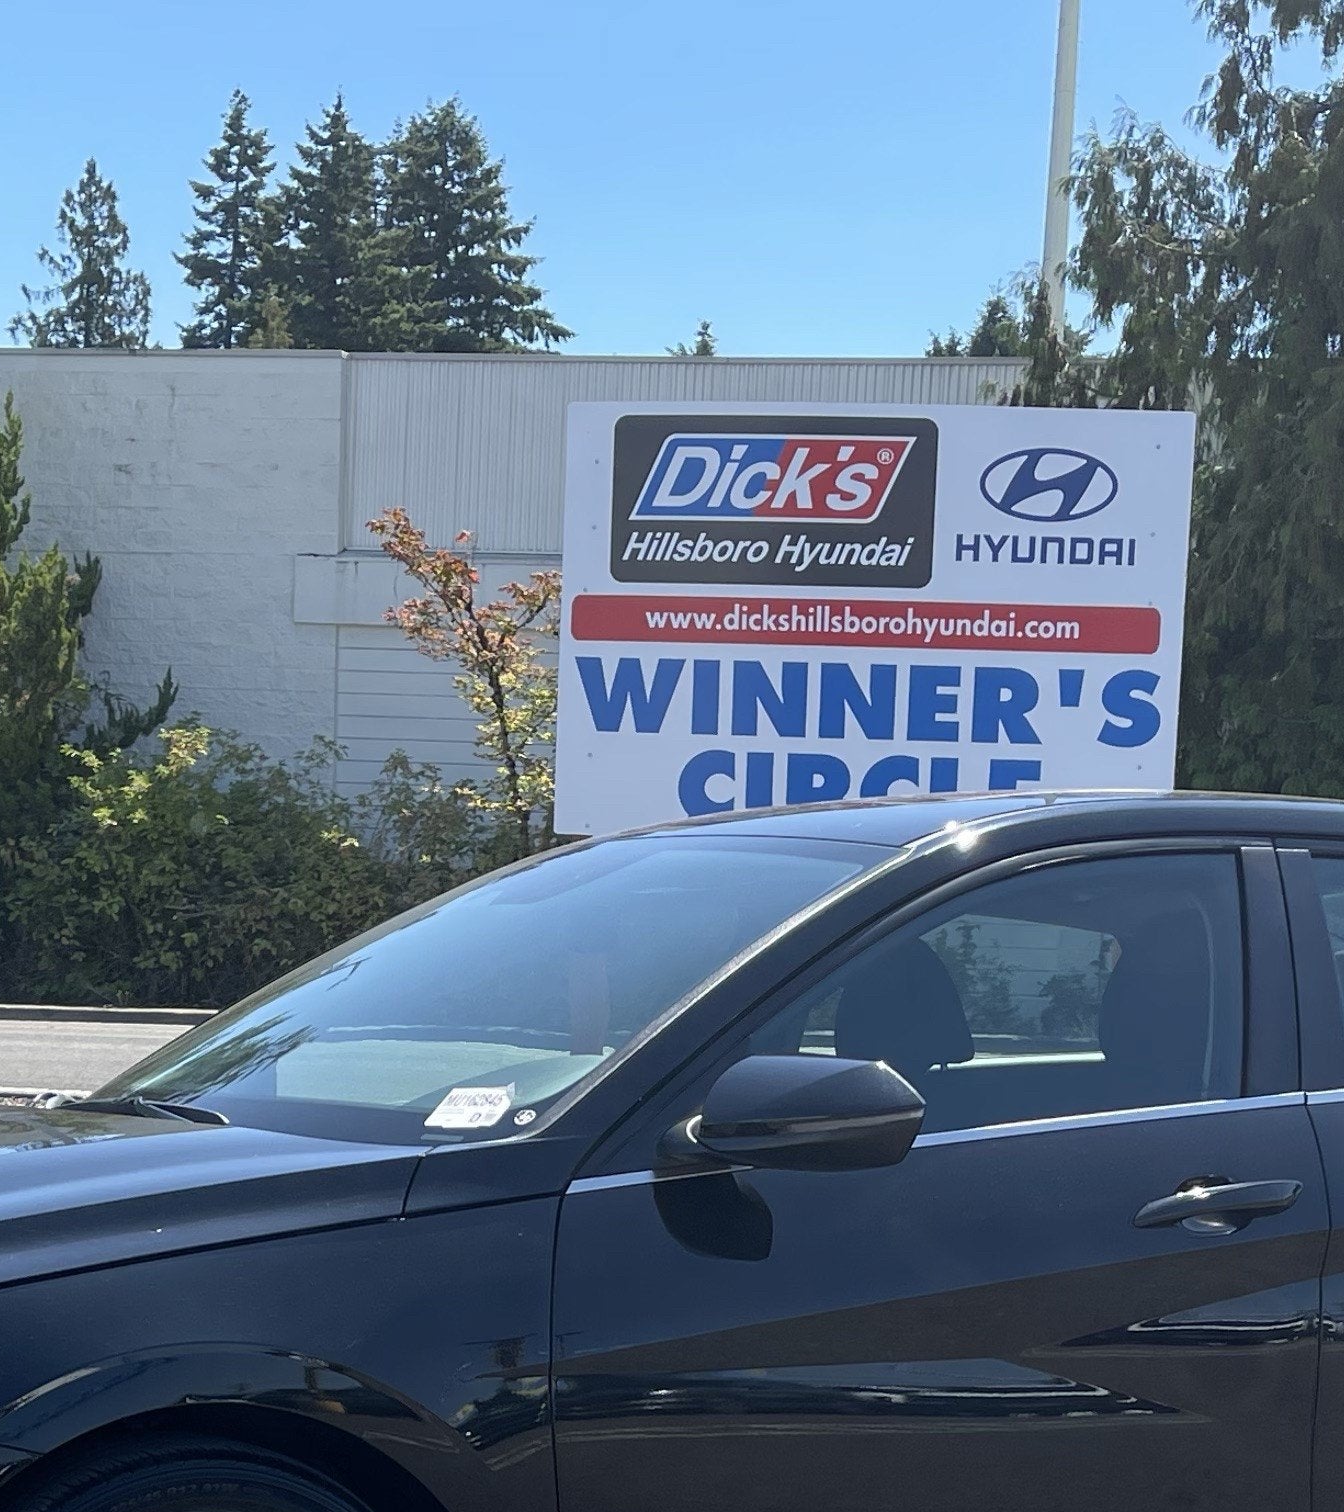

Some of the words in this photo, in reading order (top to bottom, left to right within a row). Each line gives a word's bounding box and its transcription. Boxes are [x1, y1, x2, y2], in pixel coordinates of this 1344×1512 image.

[652, 446, 879, 511] Dick's
[621, 531, 769, 564] Hillsboro
[773, 535, 915, 572] Hyundai
[955, 534, 1137, 567] HYUNDAI
[645, 604, 1081, 644] www.dickshillsborohyundai.com
[575, 656, 1162, 748] WINNER'S
